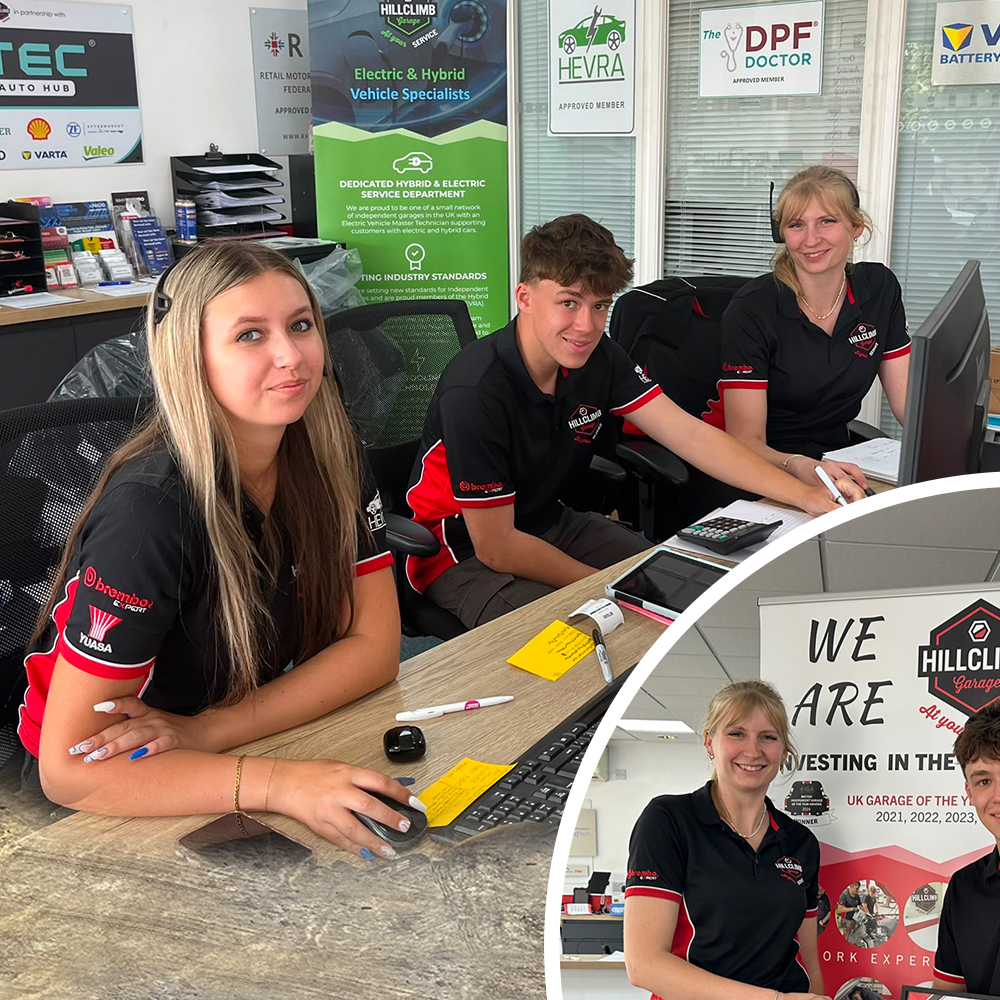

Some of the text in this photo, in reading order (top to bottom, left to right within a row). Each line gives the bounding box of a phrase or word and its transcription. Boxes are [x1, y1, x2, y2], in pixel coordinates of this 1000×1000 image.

[380, 4, 436, 16] HILLCLIMB
[412, 29, 438, 48] SERVICE
[703, 30, 721, 40] The
[746, 22, 813, 52] DPF
[559, 53, 625, 80] HEVRA
[746, 53, 811, 68] DOCTOR
[354, 68, 465, 82] Electric & Hybrid
[350, 88, 470, 102] Vehicle Specialists
[83, 146, 114, 156] Valeo
[568, 410, 602, 429] HILLCLIMB
[95, 578, 154, 609] brembo
[112, 600, 148, 614] EXPERT
[79, 632, 113, 654] YUASA
[808, 616, 886, 663] WE
[791, 680, 894, 726] ARE
[919, 704, 964, 736] At you
[888, 754, 909, 771] IN
[915, 753, 955, 771] THE
[847, 795, 958, 806] UK GARAGE OF THE
[876, 811, 977, 824] 2021, 2022, 2023,
